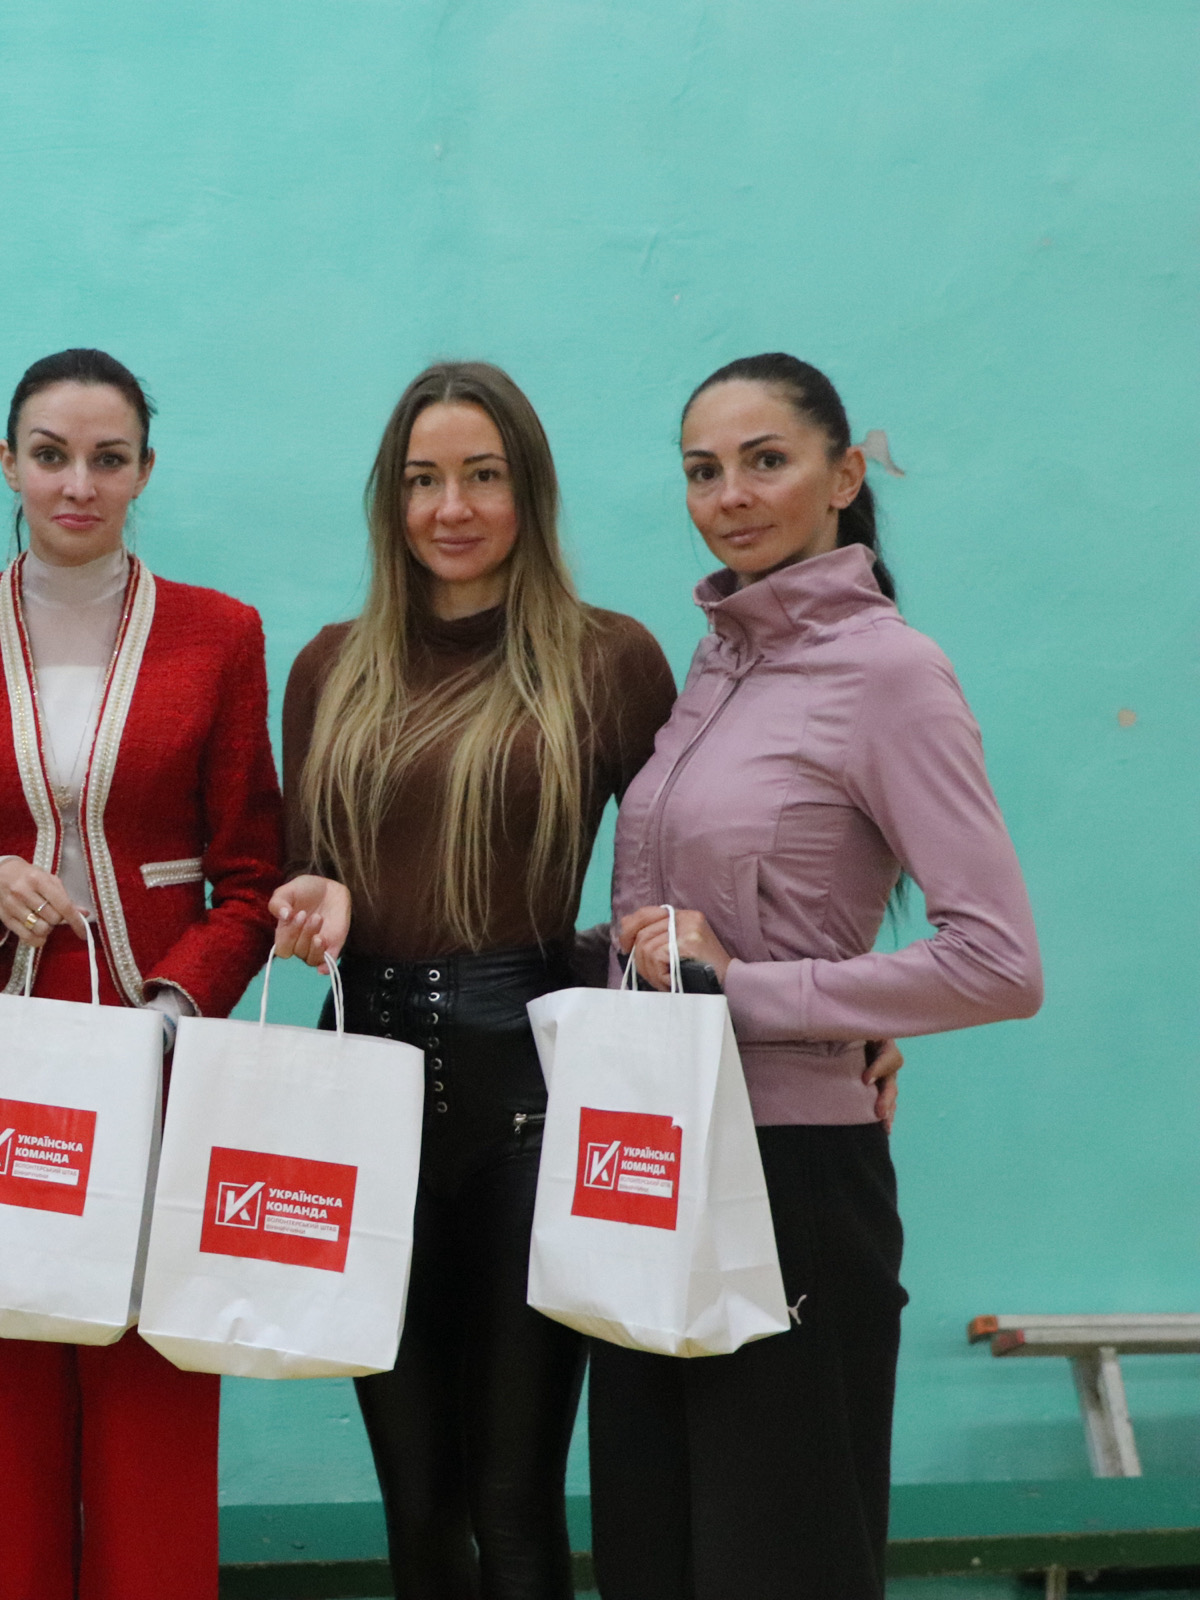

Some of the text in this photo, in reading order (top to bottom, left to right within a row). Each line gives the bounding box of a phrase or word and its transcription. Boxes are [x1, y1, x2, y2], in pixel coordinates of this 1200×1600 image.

[18, 1135, 83, 1152] УКРАЇНСЬКА
[15, 1147, 69, 1163] КОМАНДА
[624, 1147, 675, 1162] УКРАЇНСЬКА
[621, 1160, 666, 1175] КОМАНДА
[269, 1188, 342, 1207] УКРАЇНСЬКА
[266, 1201, 328, 1218] КОМАНДА
